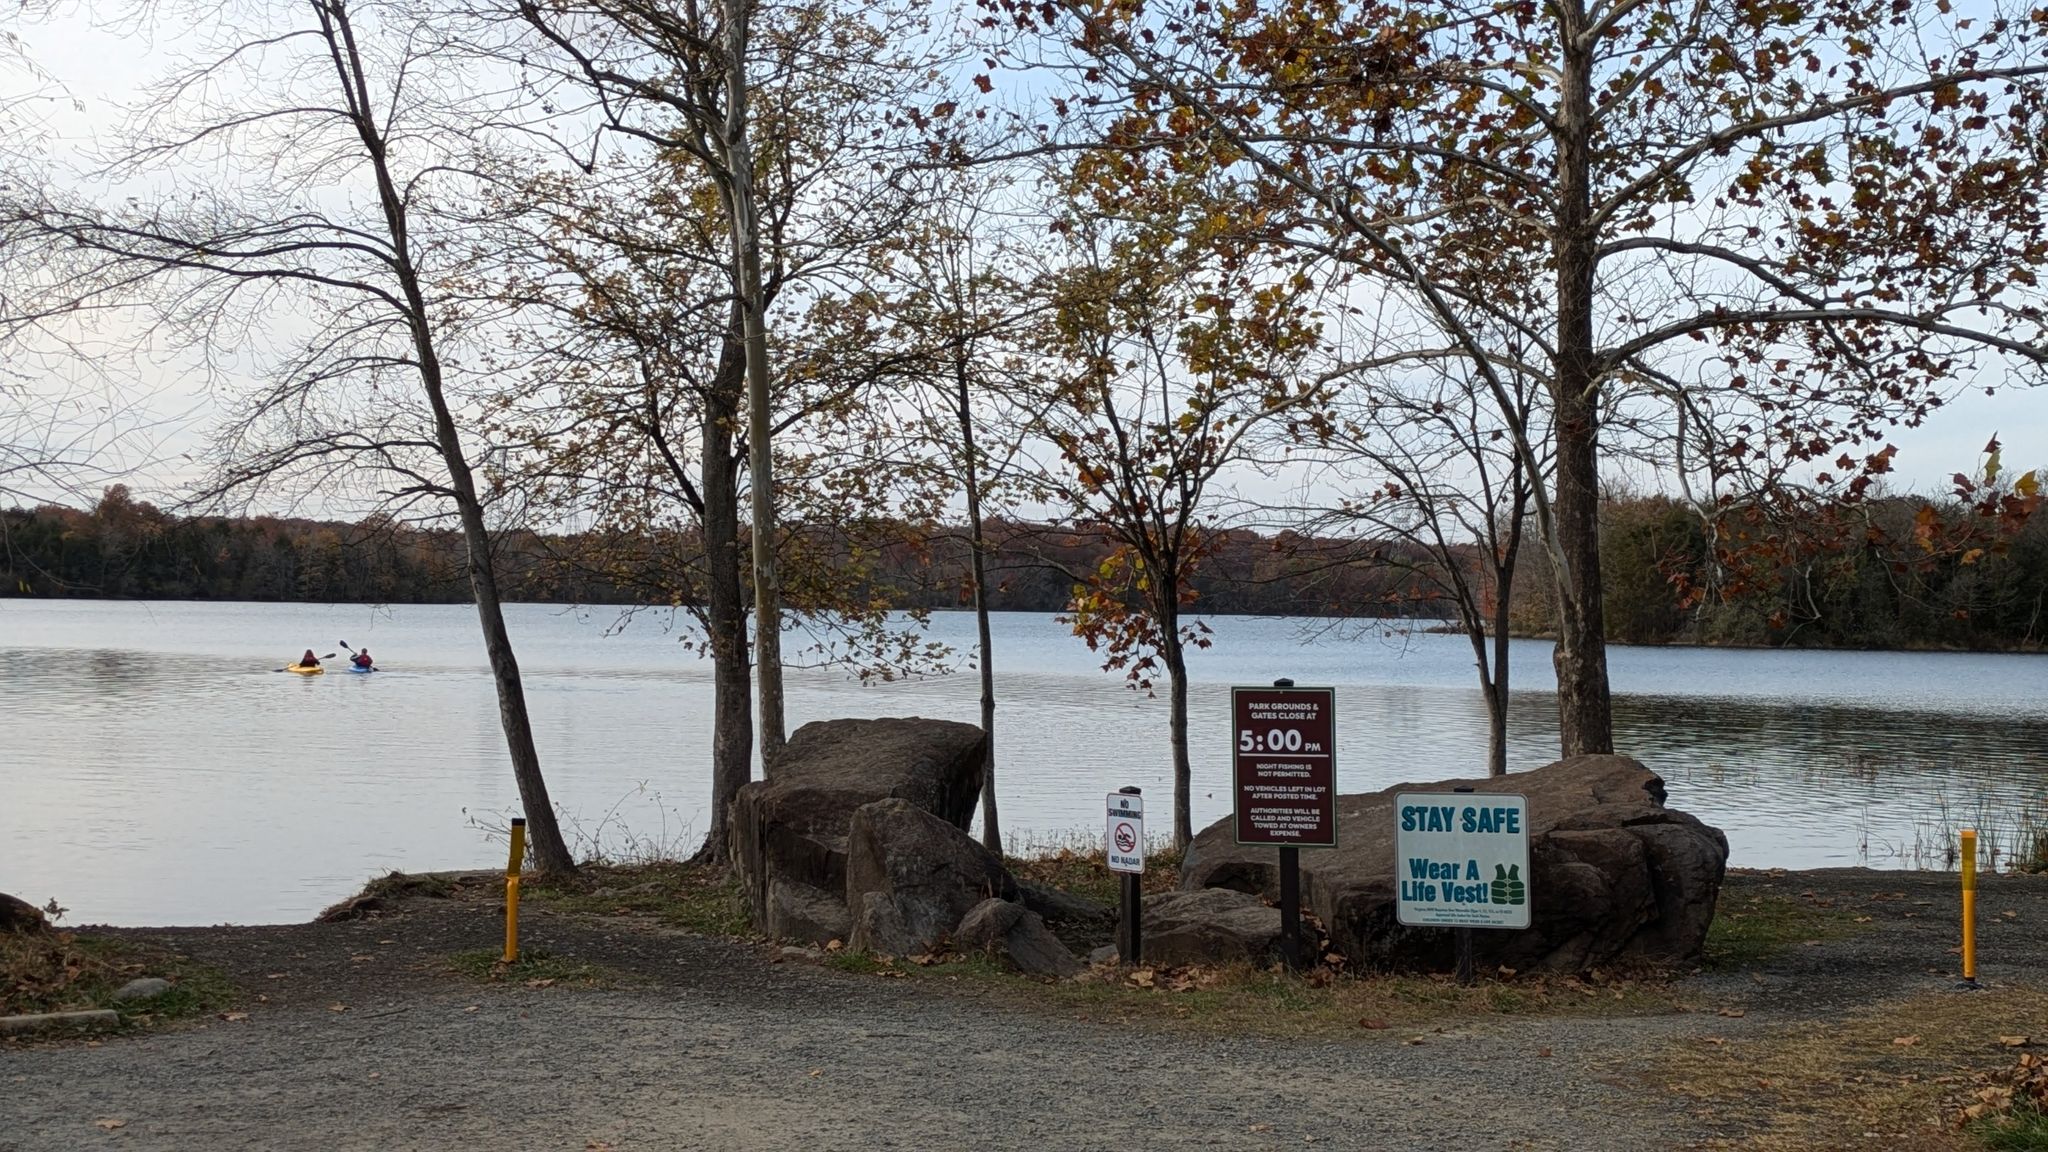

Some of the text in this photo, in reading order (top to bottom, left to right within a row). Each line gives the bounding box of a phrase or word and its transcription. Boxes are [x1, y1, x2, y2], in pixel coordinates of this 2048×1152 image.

[1240, 729, 1321, 751] 5:00 PM
[1120, 800, 1129, 808] NO
[1401, 806, 1520, 833] STAY SAFE
[1409, 859, 1479, 880] Wear A
[1402, 881, 1488, 903] Life Vest!
